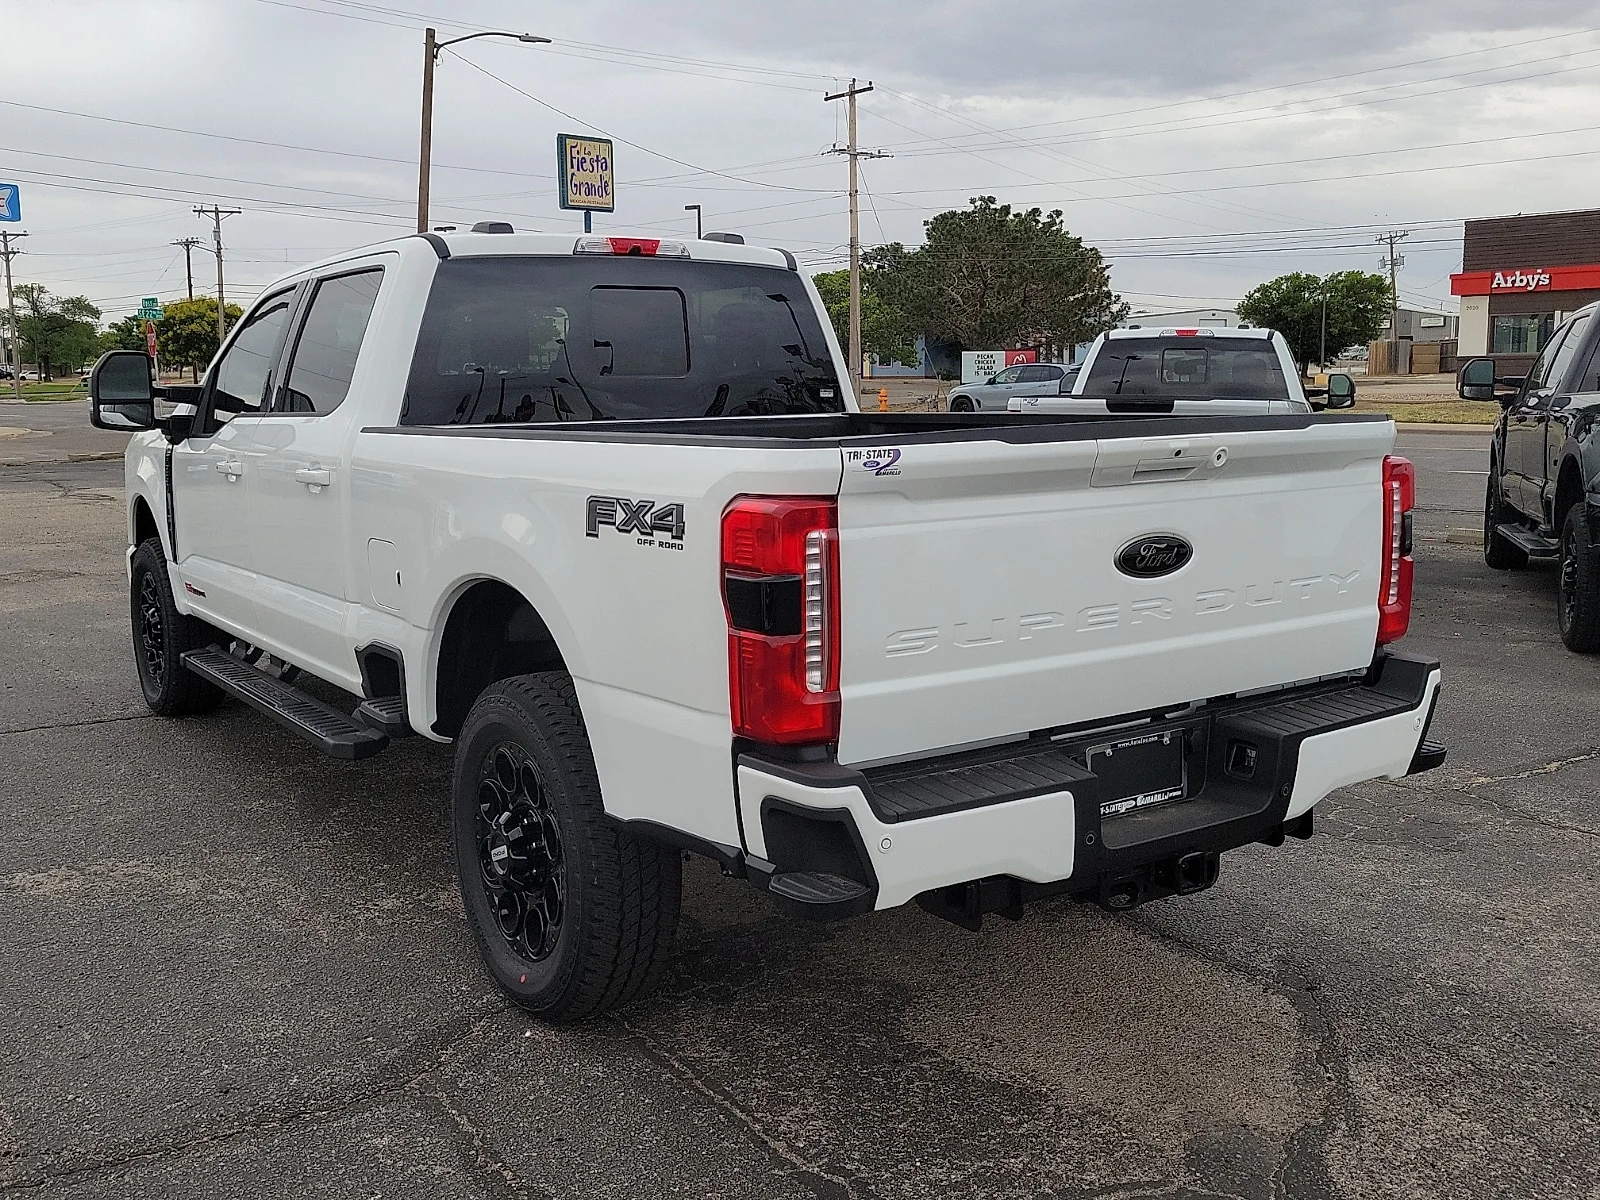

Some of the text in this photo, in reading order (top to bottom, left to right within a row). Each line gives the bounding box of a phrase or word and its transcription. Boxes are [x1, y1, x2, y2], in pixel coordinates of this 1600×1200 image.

[569, 142, 608, 173] Fiesta
[1491, 269, 1550, 291] Arby's
[846, 449, 893, 463] TRI-STATE
[585, 496, 686, 541] FX4
[636, 538, 684, 551] OFF ROAD
[1135, 542, 1178, 569] Ford
[885, 569, 1361, 659] SUPER DUTY
